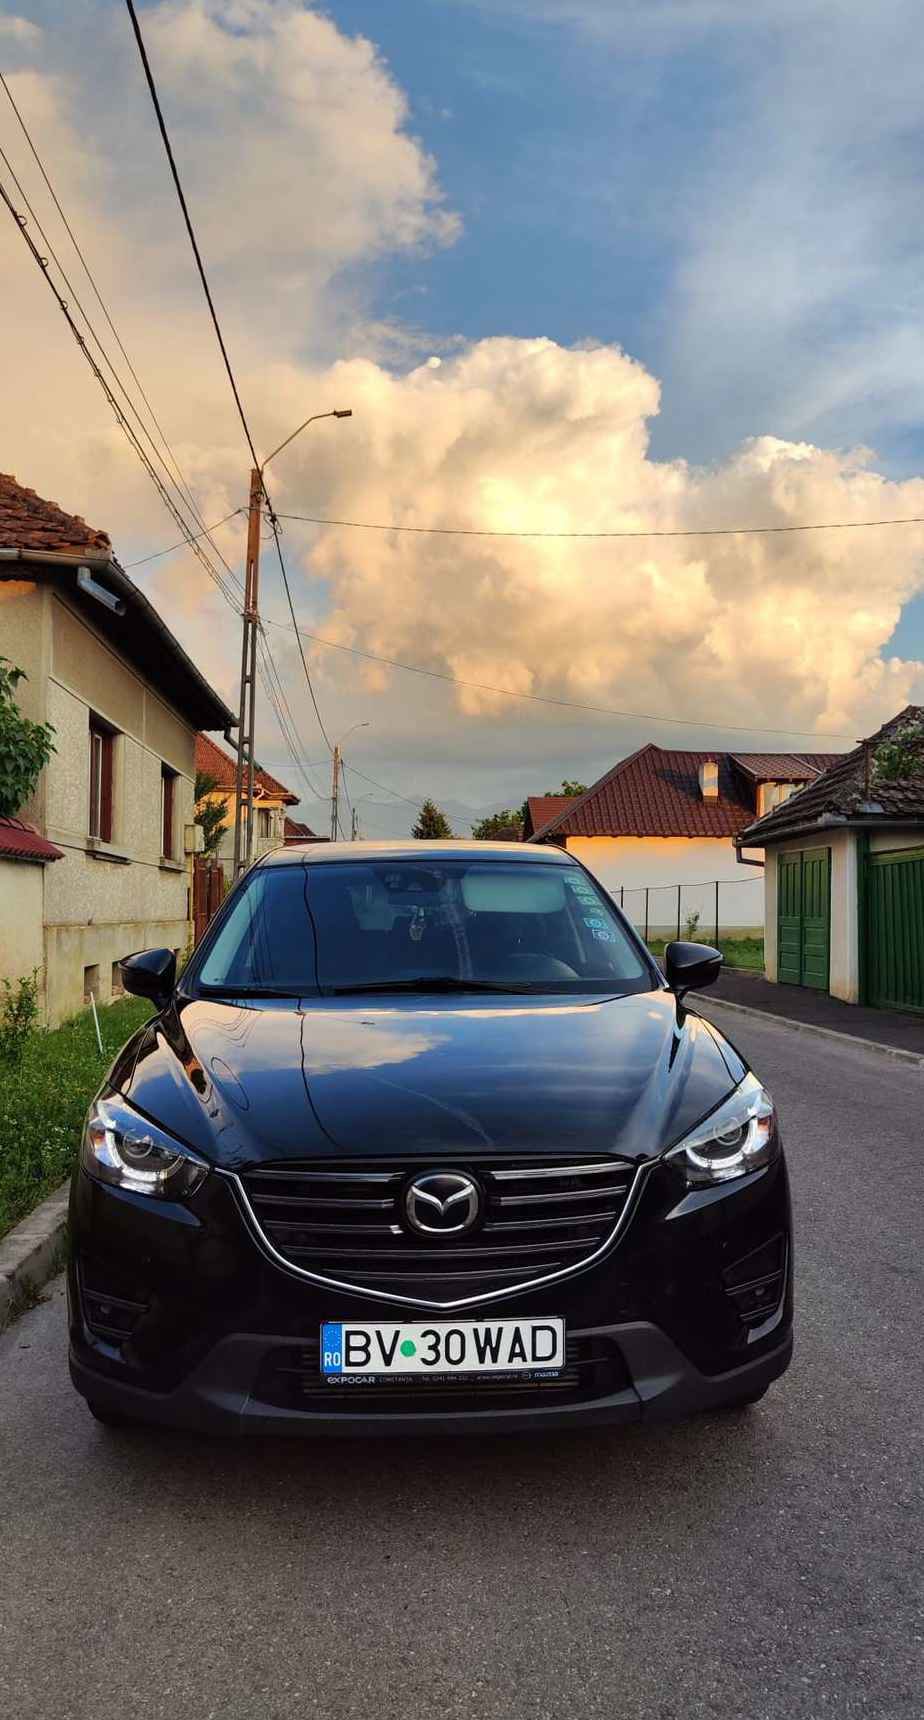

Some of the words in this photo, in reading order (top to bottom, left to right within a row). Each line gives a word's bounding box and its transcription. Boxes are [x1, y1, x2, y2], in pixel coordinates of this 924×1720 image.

[324, 1352, 341, 1367] RO
[345, 1330, 401, 1367] BV
[420, 1329, 466, 1366] 30
[473, 1325, 558, 1364] WAD
